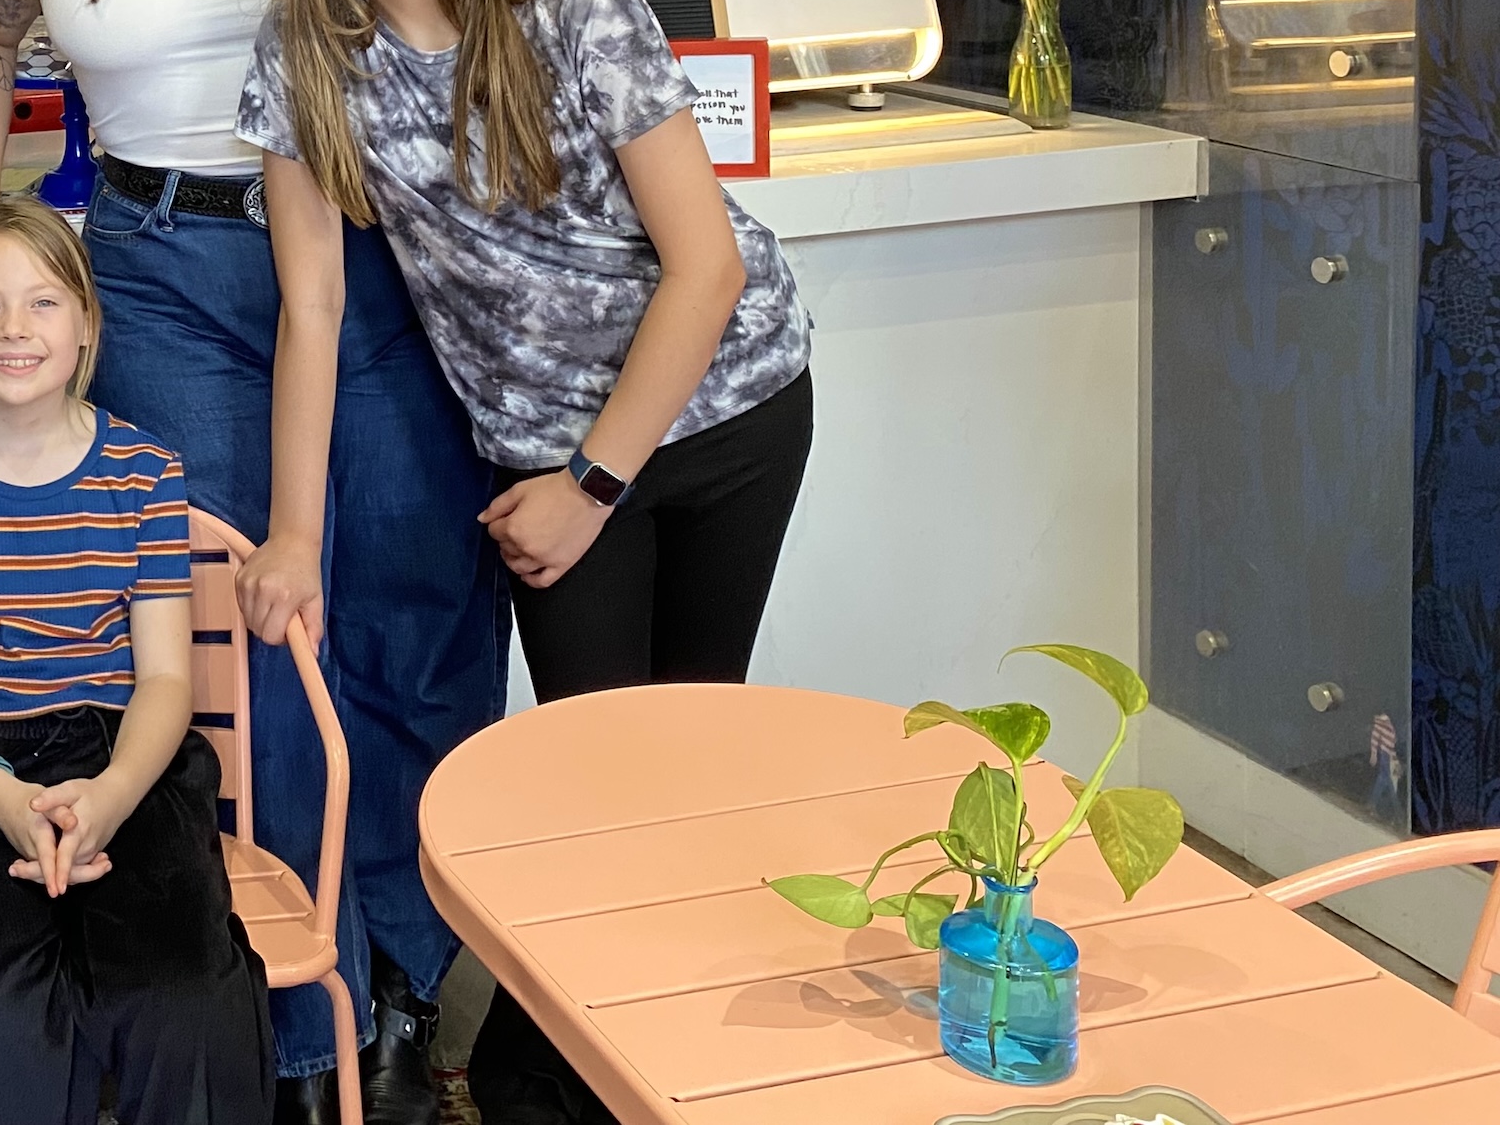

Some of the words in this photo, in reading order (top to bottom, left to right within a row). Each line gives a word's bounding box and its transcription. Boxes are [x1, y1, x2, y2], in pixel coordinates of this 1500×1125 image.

[714, 88, 739, 98] that
[729, 104, 745, 115] you
[695, 116, 713, 124] ove
[716, 115, 743, 126] them
